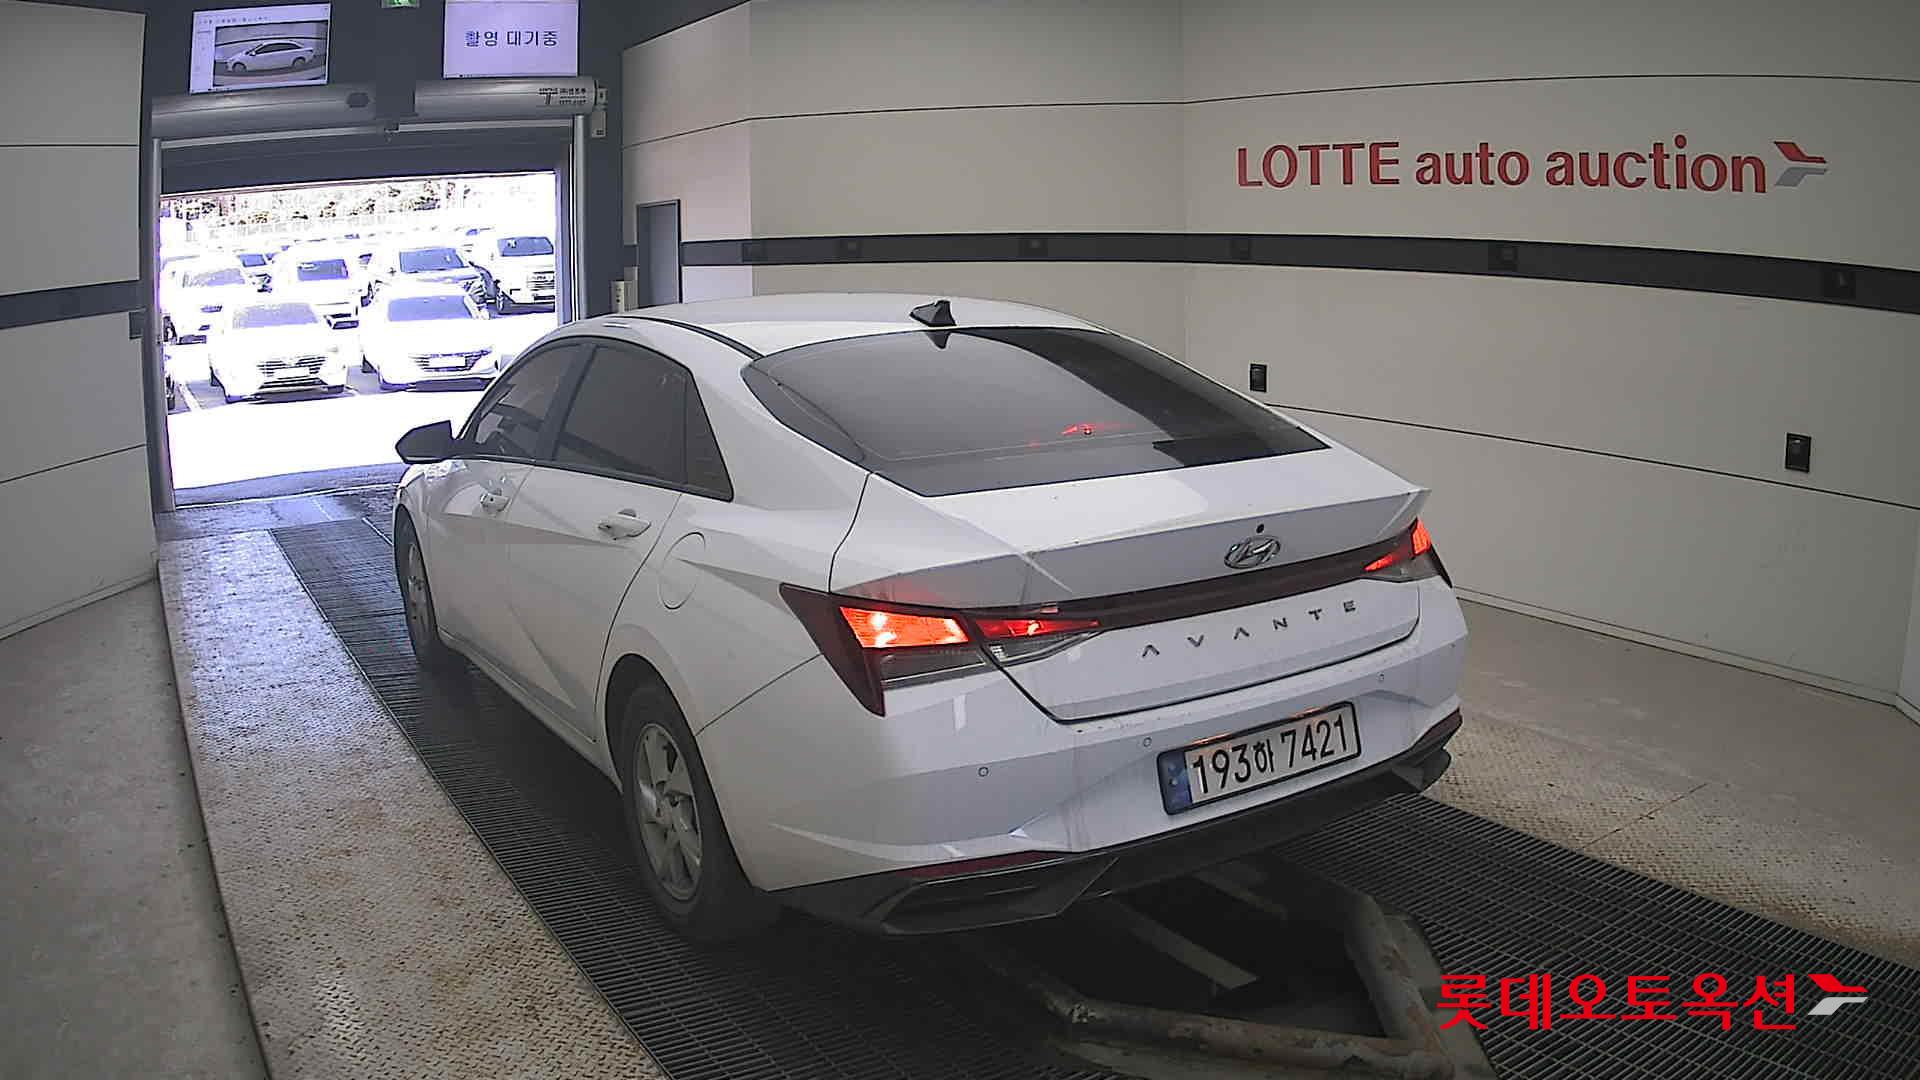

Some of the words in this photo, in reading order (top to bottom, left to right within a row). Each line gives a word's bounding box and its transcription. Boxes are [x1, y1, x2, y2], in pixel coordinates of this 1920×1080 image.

[507, 31, 558, 46] 대기중
[1237, 142, 1400, 187] LOTTE
[1416, 143, 1530, 186] auto
[1546, 135, 1766, 194] auction
[1142, 599, 1357, 658] AVANTE
[1192, 738, 1275, 794] 193하
[1280, 714, 1347, 768] 7421
